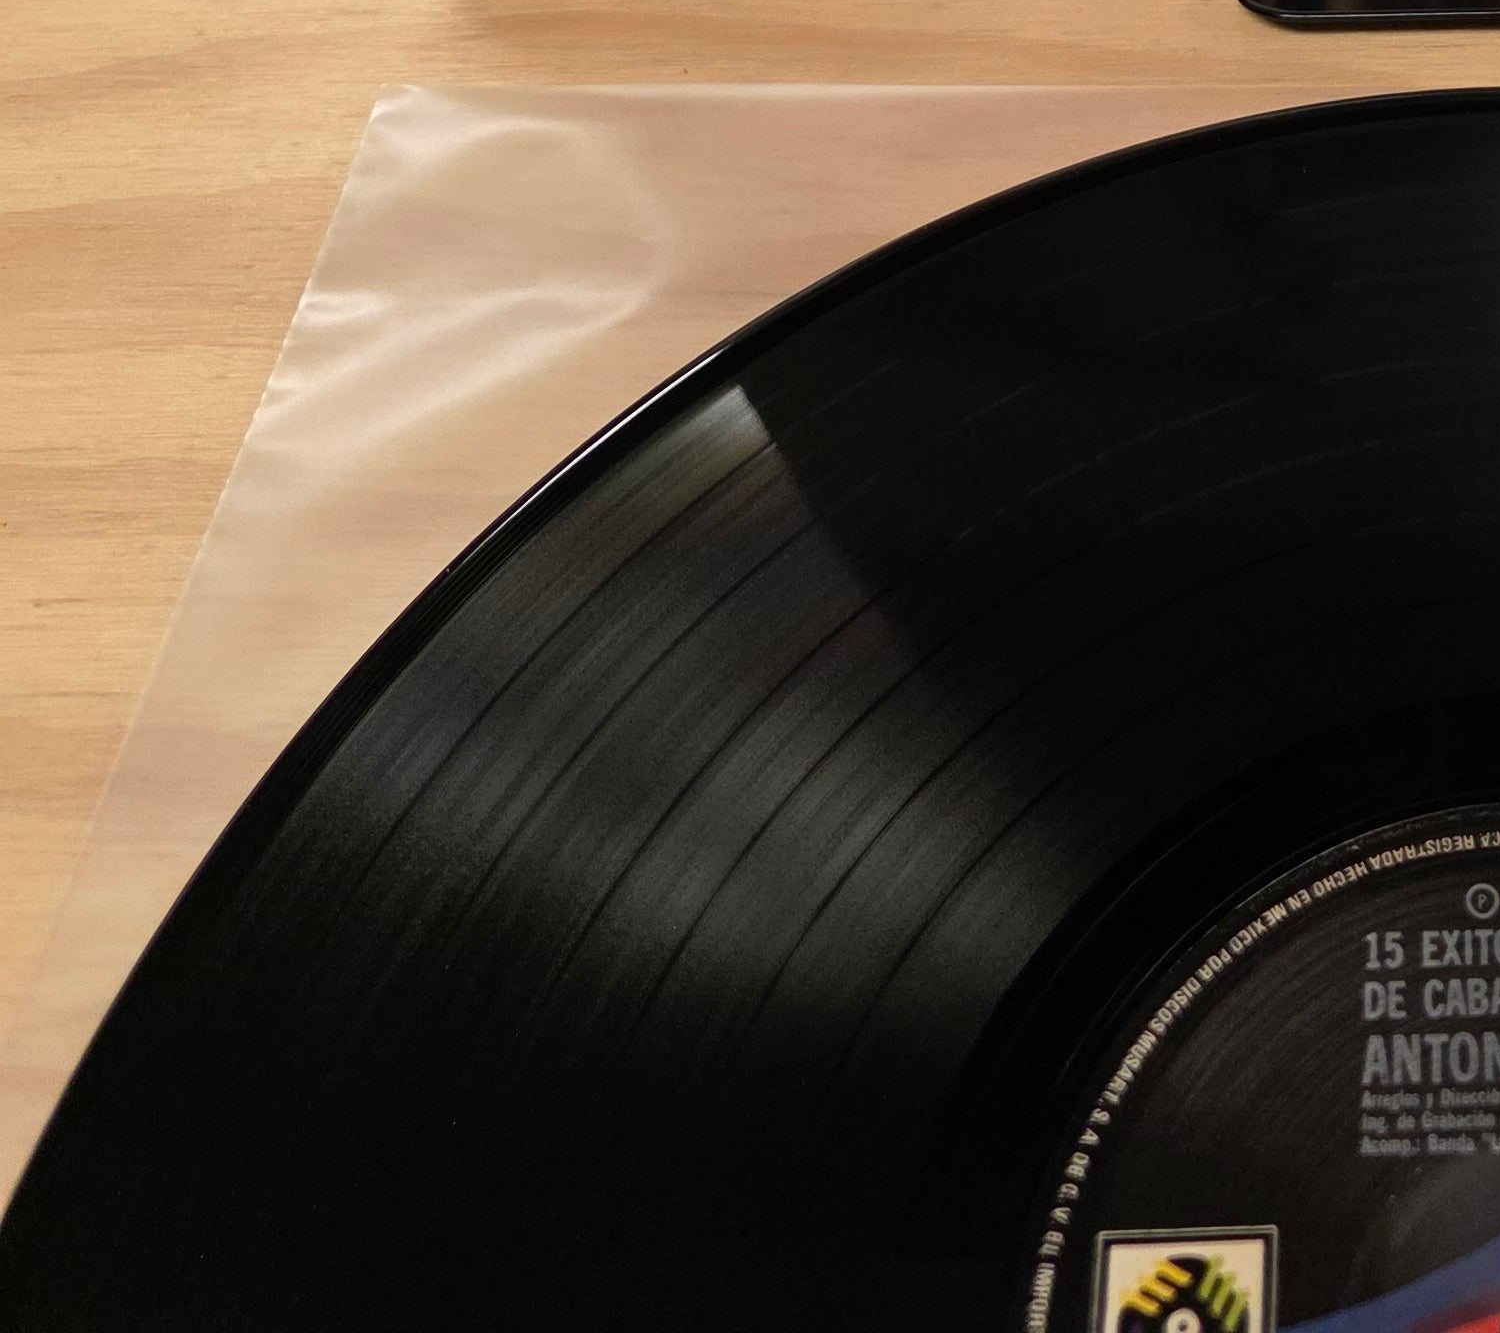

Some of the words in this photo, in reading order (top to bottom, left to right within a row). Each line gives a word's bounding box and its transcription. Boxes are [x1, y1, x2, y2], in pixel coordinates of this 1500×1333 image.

[1366, 834, 1476, 871] REGISTRADA
[1284, 888, 1314, 912] EN
[1310, 861, 1370, 900] HECHO
[1227, 902, 1289, 957] MEXICO
[1194, 947, 1235, 986] POR
[1363, 930, 1406, 970] 15
[1147, 975, 1204, 1037] DISCOS
[1362, 979, 1408, 1021] DE
